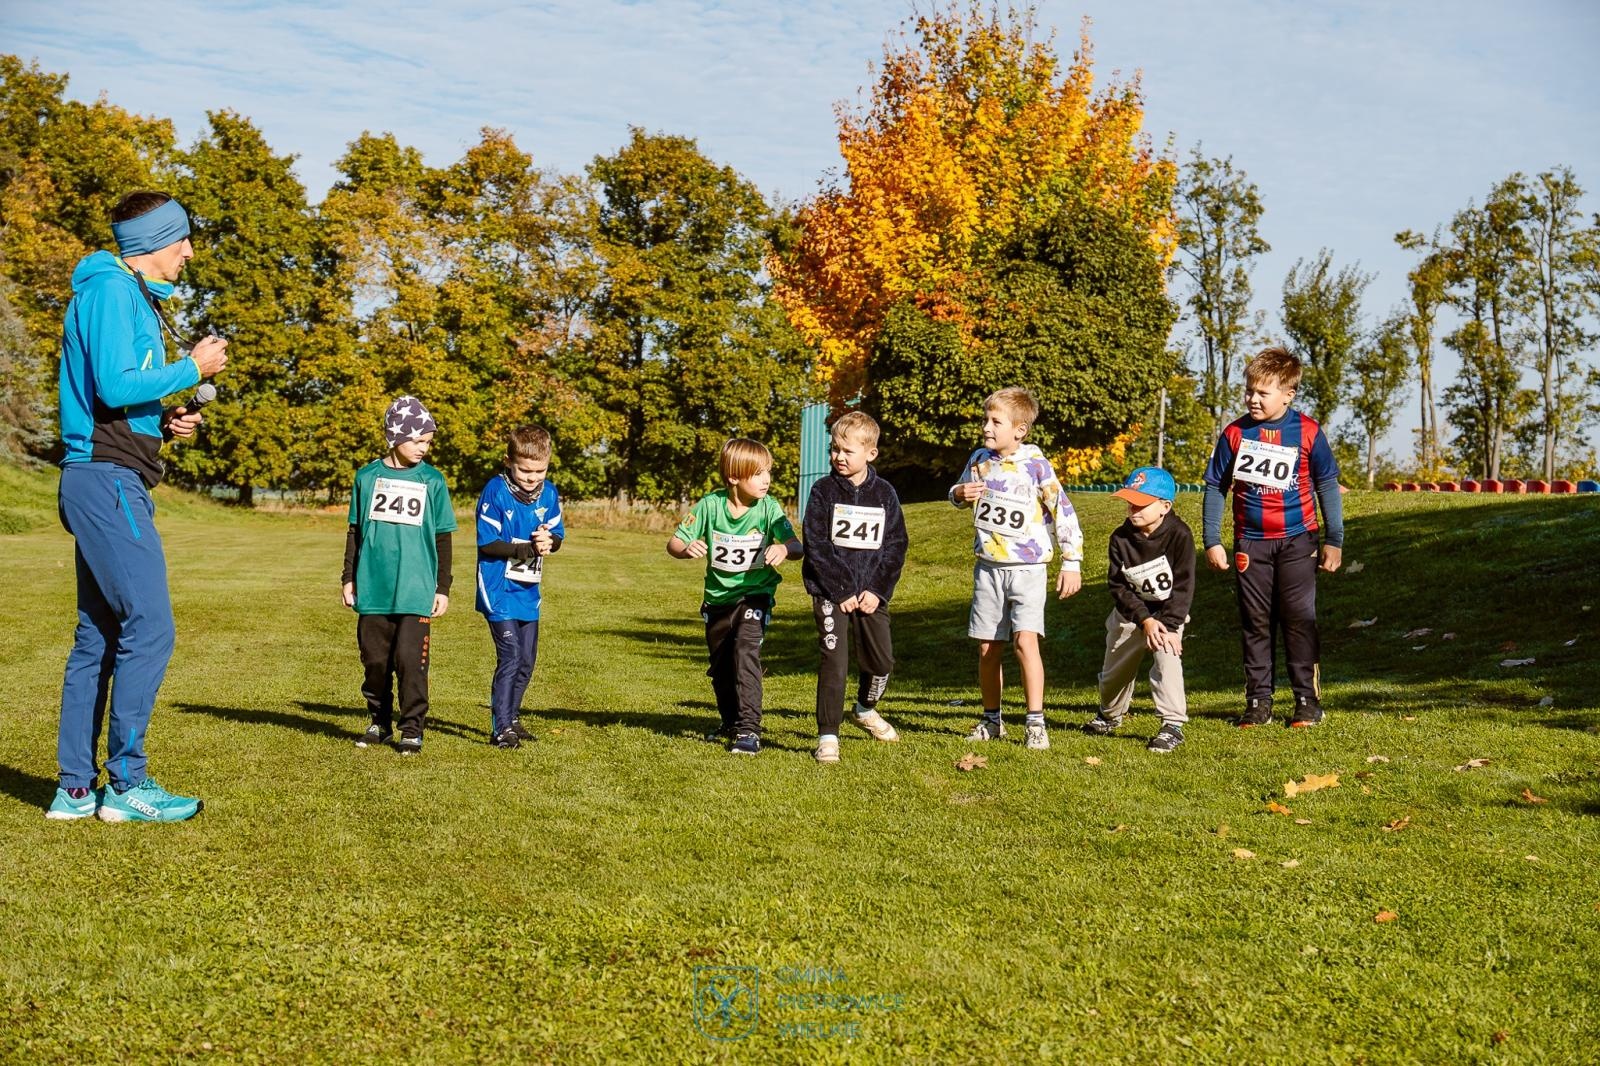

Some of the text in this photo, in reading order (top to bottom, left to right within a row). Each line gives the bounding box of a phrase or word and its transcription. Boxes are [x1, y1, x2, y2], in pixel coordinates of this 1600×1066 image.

[1238, 454, 1289, 481] 240
[373, 493, 421, 517] 249
[978, 502, 1025, 529] 239
[835, 519, 880, 542] 241
[715, 546, 763, 565] 237
[125, 795, 162, 818] TERREX
